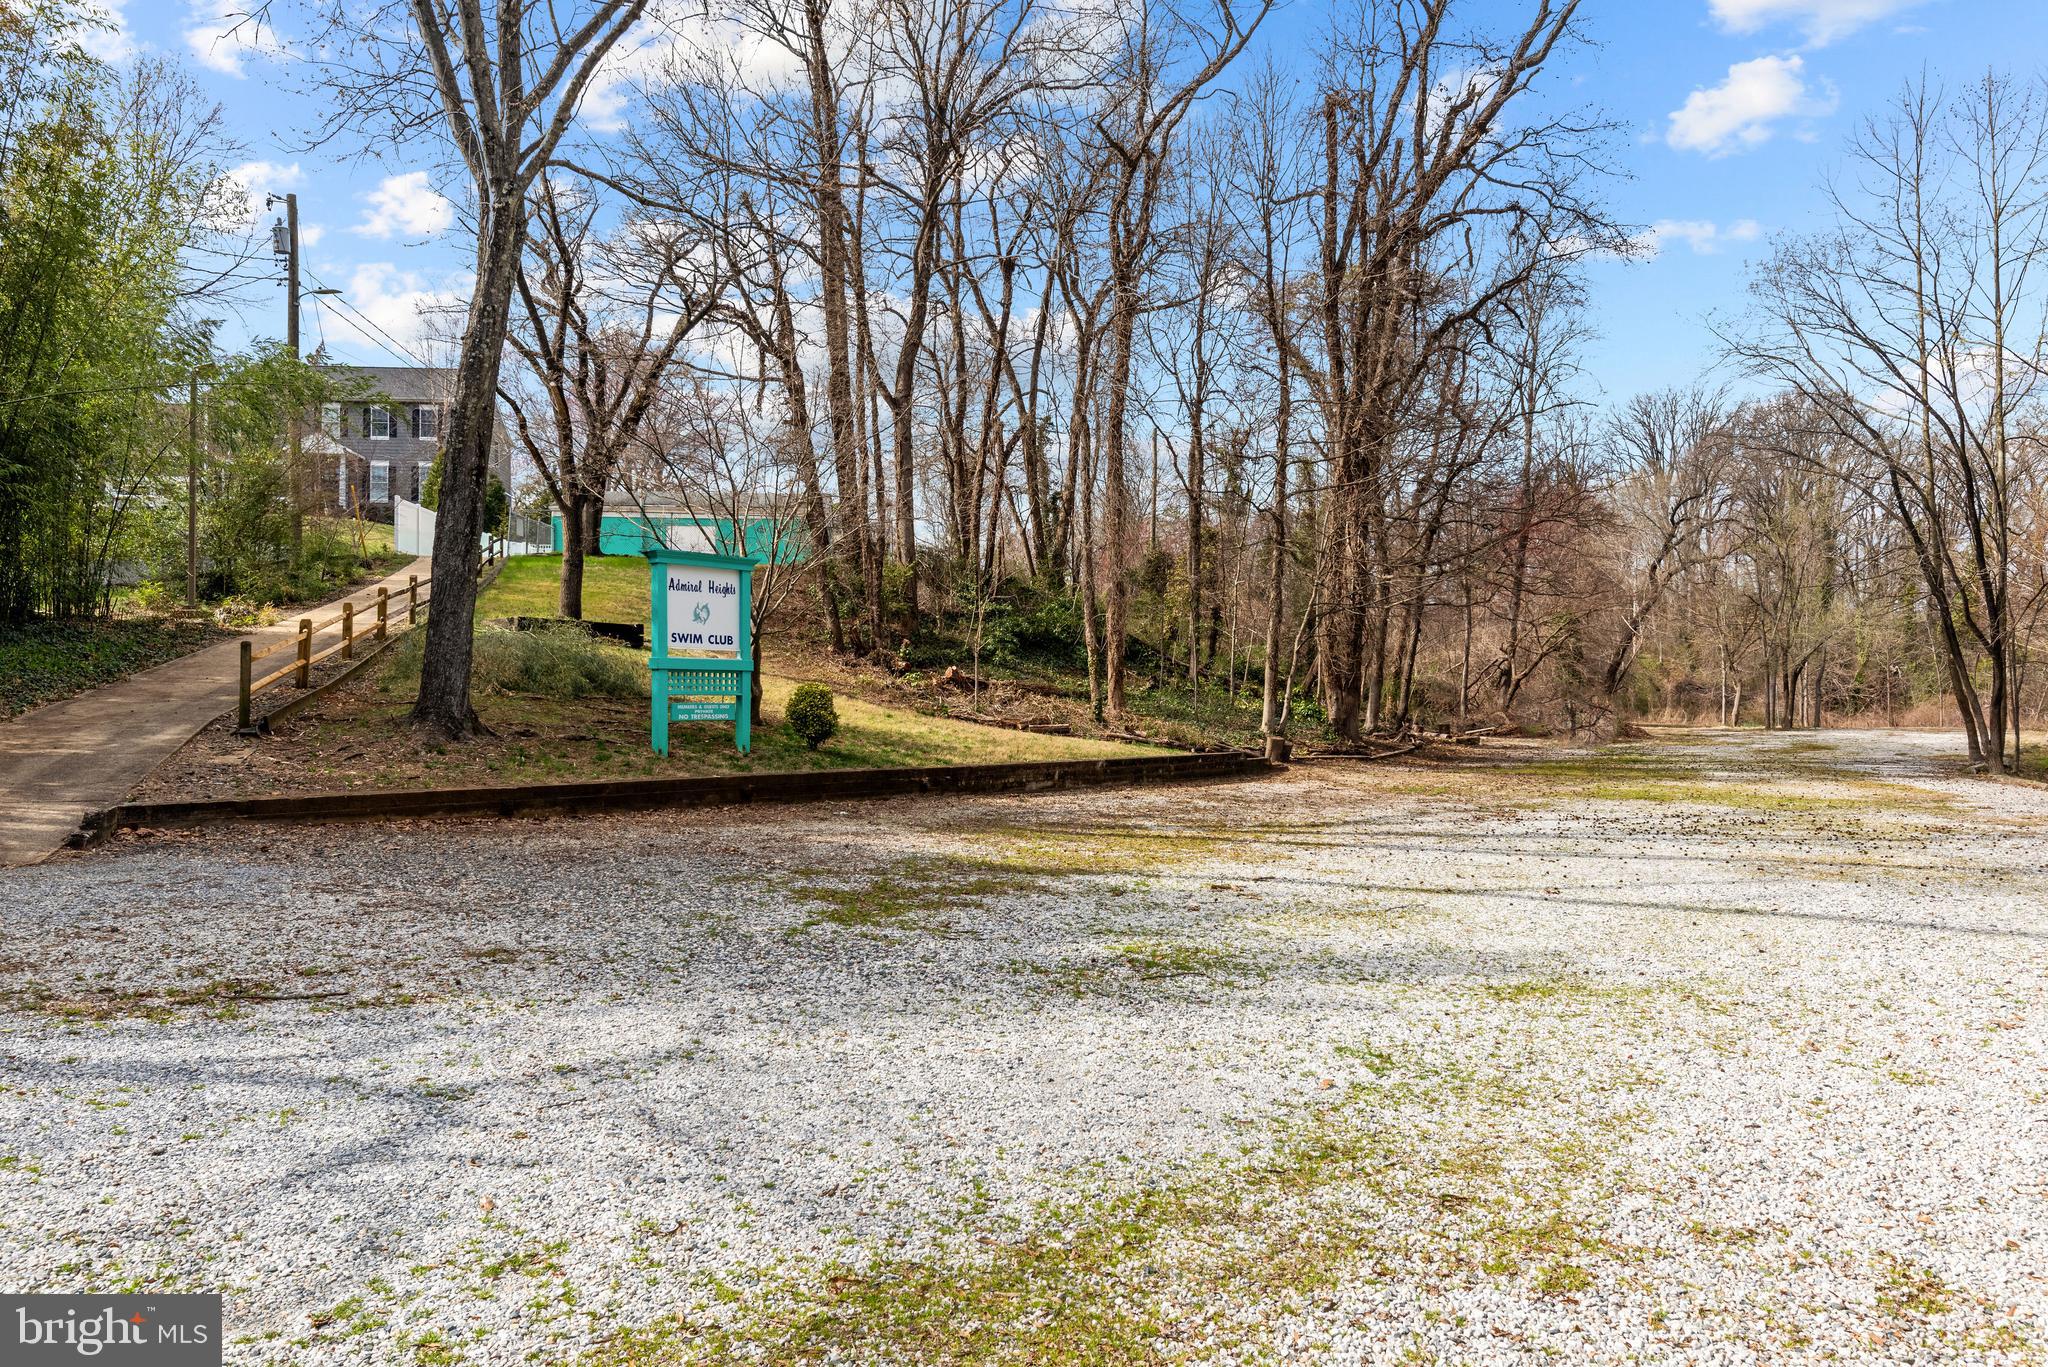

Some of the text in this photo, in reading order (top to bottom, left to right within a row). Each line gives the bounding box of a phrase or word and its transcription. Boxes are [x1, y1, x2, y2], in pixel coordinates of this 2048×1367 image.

[669, 577, 736, 598] Admiral Heights
[671, 632, 734, 646] SWIM CLUB
